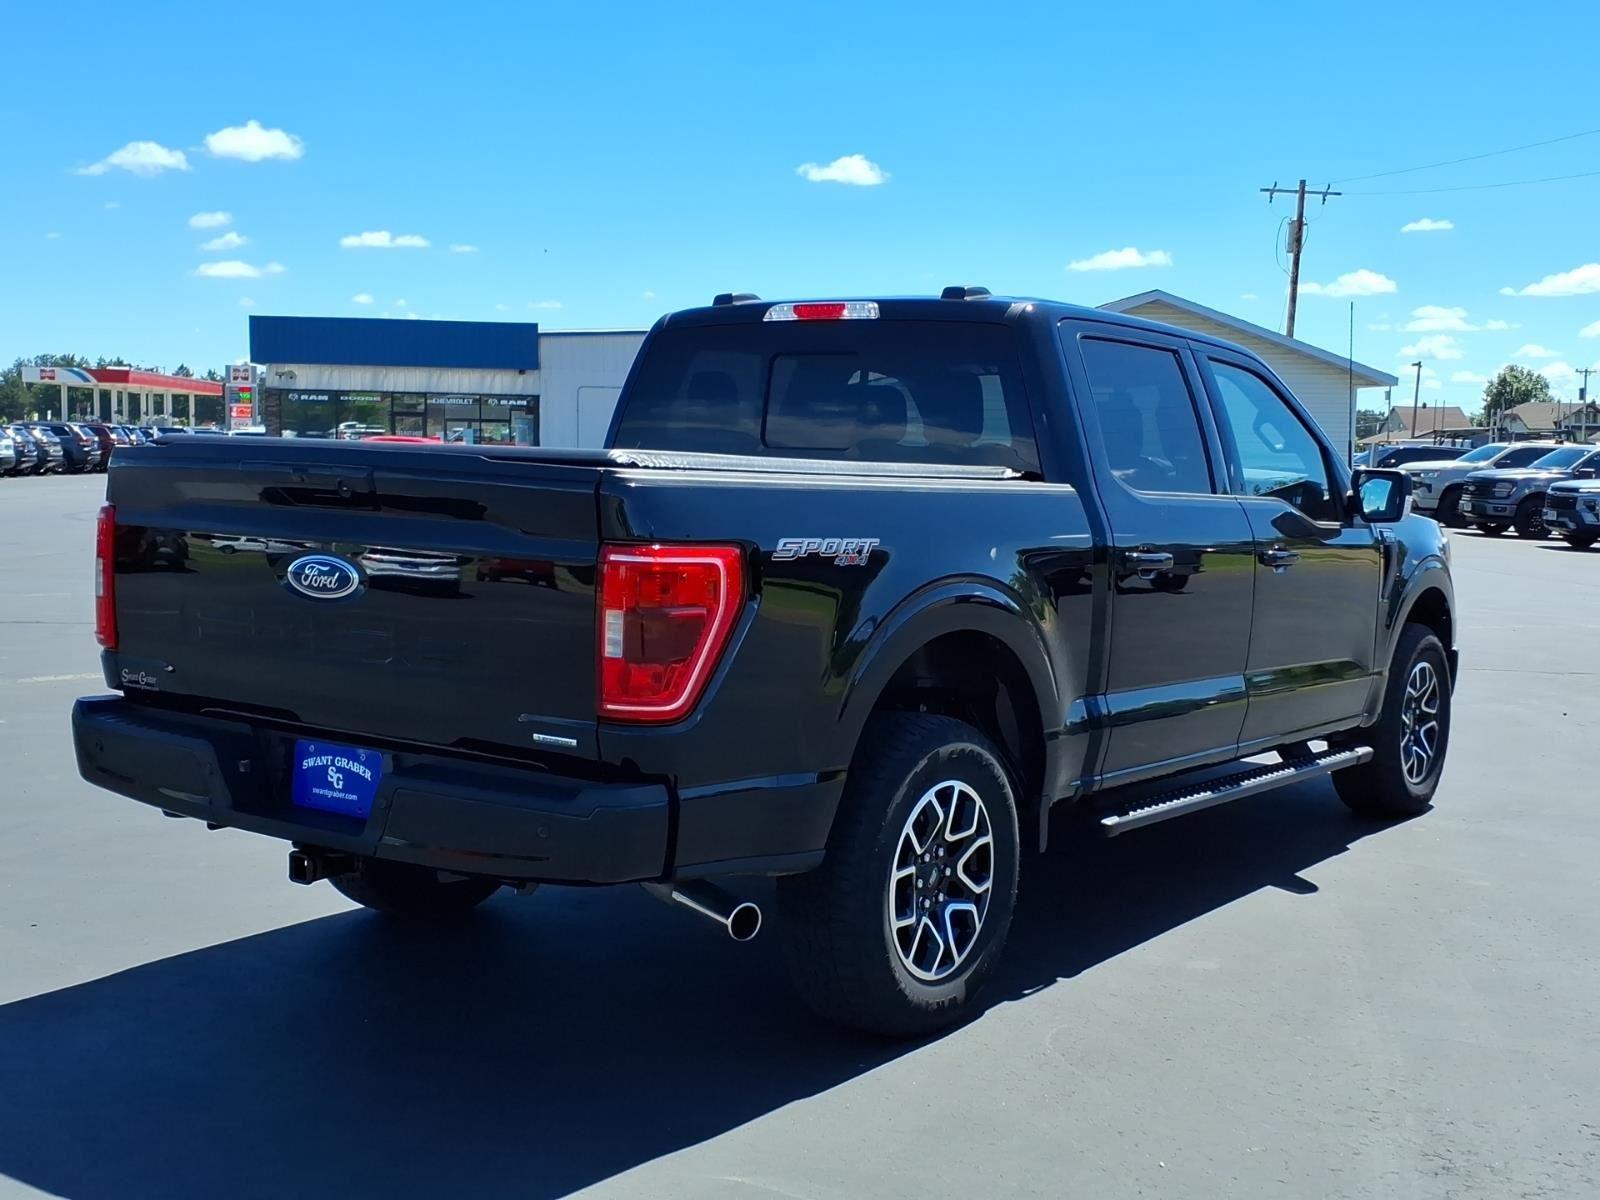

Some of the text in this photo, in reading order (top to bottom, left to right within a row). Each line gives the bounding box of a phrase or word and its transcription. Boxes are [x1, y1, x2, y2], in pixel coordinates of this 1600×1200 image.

[771, 538, 880, 560] SPORT
[301, 563, 339, 589] Ford
[302, 755, 371, 782] SWANT GRABER
[312, 787, 358, 801] swantgraber.com
